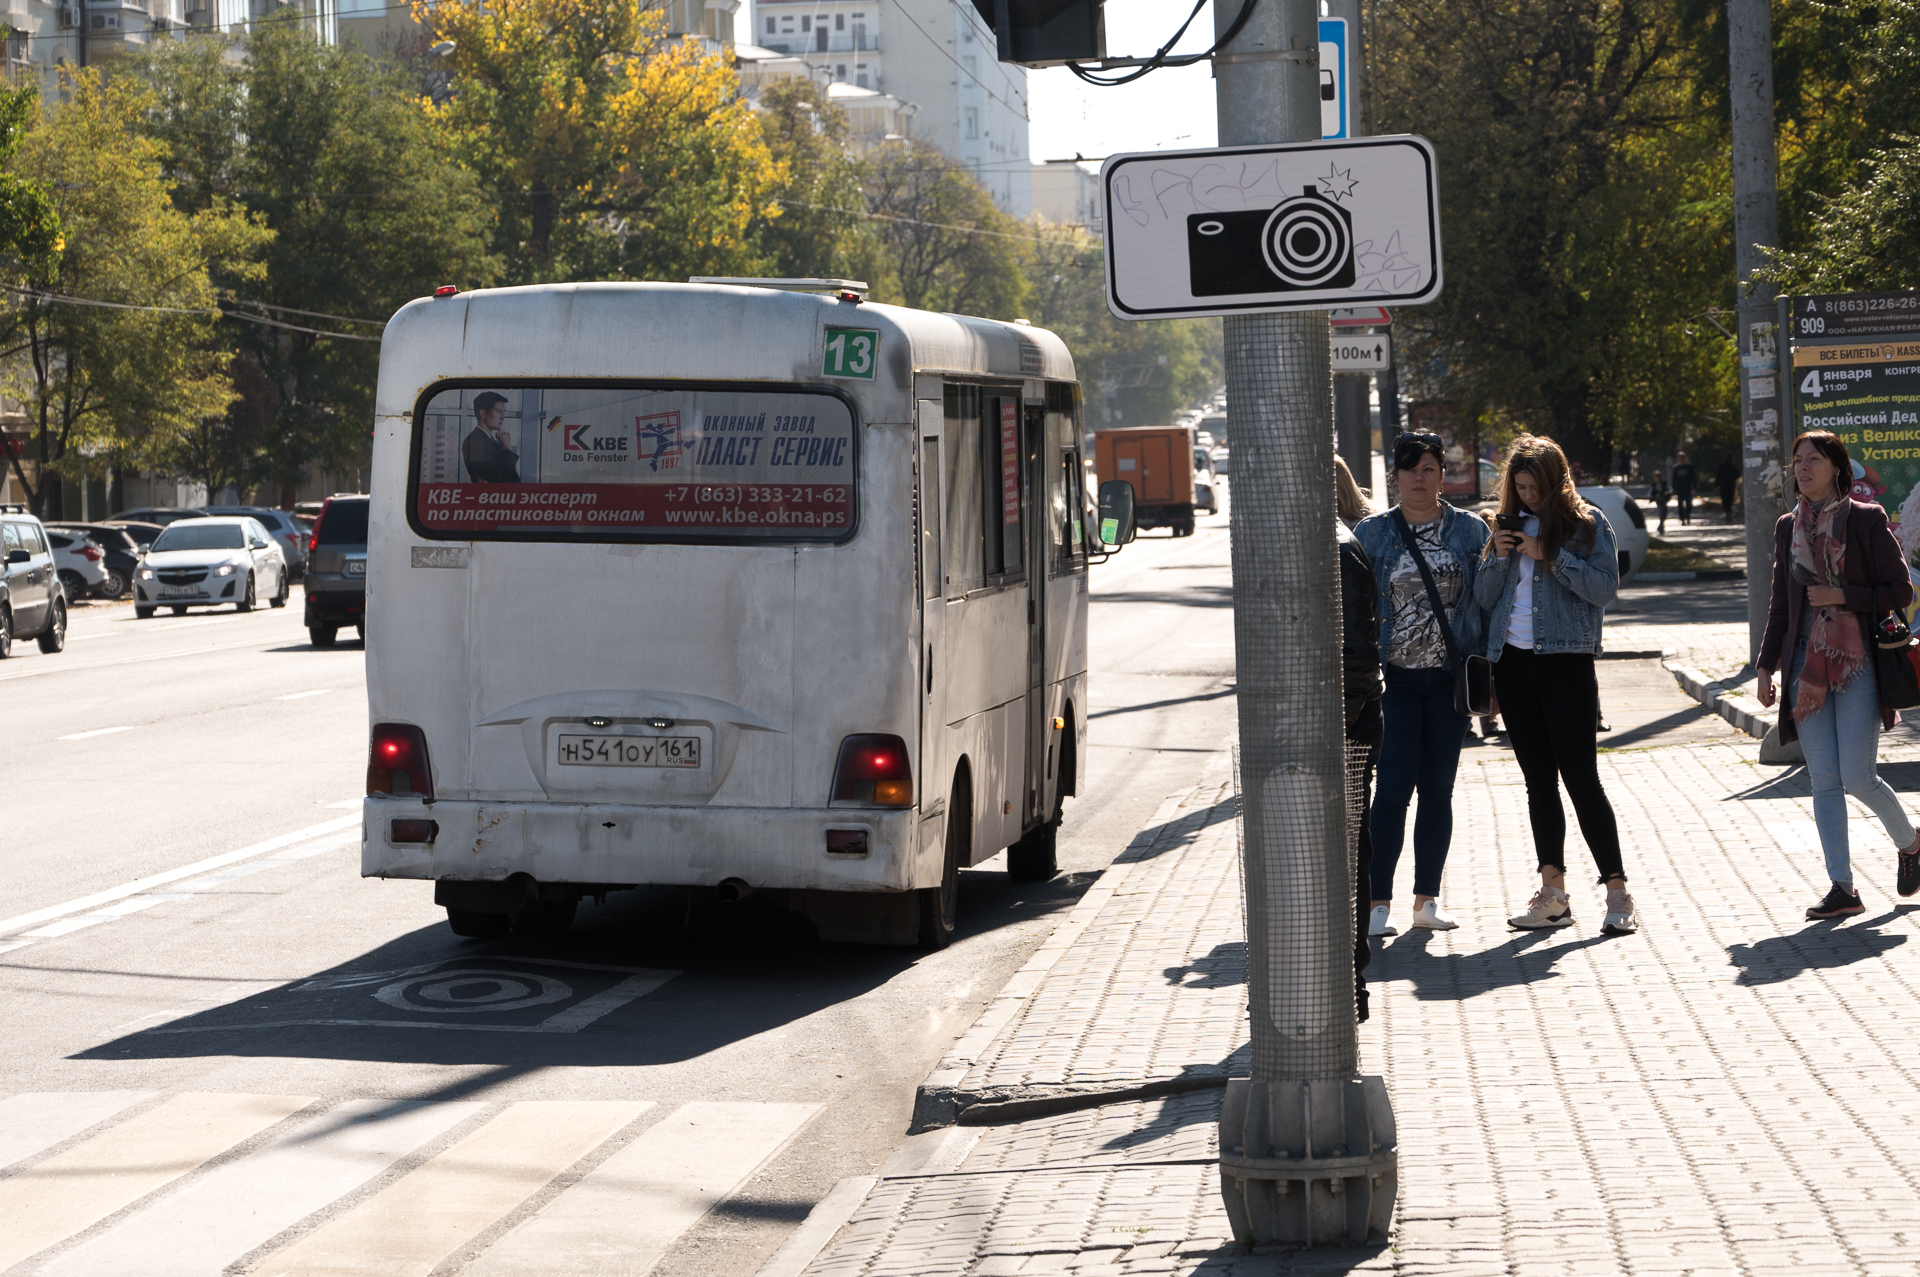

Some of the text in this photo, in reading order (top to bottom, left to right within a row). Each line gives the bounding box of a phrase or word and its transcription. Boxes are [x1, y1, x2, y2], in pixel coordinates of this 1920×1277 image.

[1801, 317, 1825, 334] 909
[829, 333, 871, 374] 13
[1820, 350, 1838, 360] ВСЕ
[1840, 348, 1879, 359] БИЛЕТЫ
[1800, 370, 1823, 397] 4
[1823, 369, 1872, 382] января
[1824, 383, 1848, 391] 11:00
[1804, 401, 1834, 412] Новое
[1836, 394, 1890, 407] волшебное
[1803, 410, 1918, 427] Российский Дед
[593, 437, 628, 451] KBE
[1839, 433, 1858, 444] из
[563, 453, 628, 462] Das Fenster
[696, 437, 848, 467] ПЛАСТ СЕРВИС
[1862, 447, 1920, 460] Устюга
[661, 457, 679, 469] 1997
[478, 492, 516, 504] ваш
[519, 492, 597, 508] эксперт
[665, 486, 846, 505] +7 (863) 333-21-62
[427, 509, 645, 521] по пластиковым окнам
[665, 506, 845, 527] www.kbe.okna.ps
[566, 739, 693, 762] Н541ОУ 161
